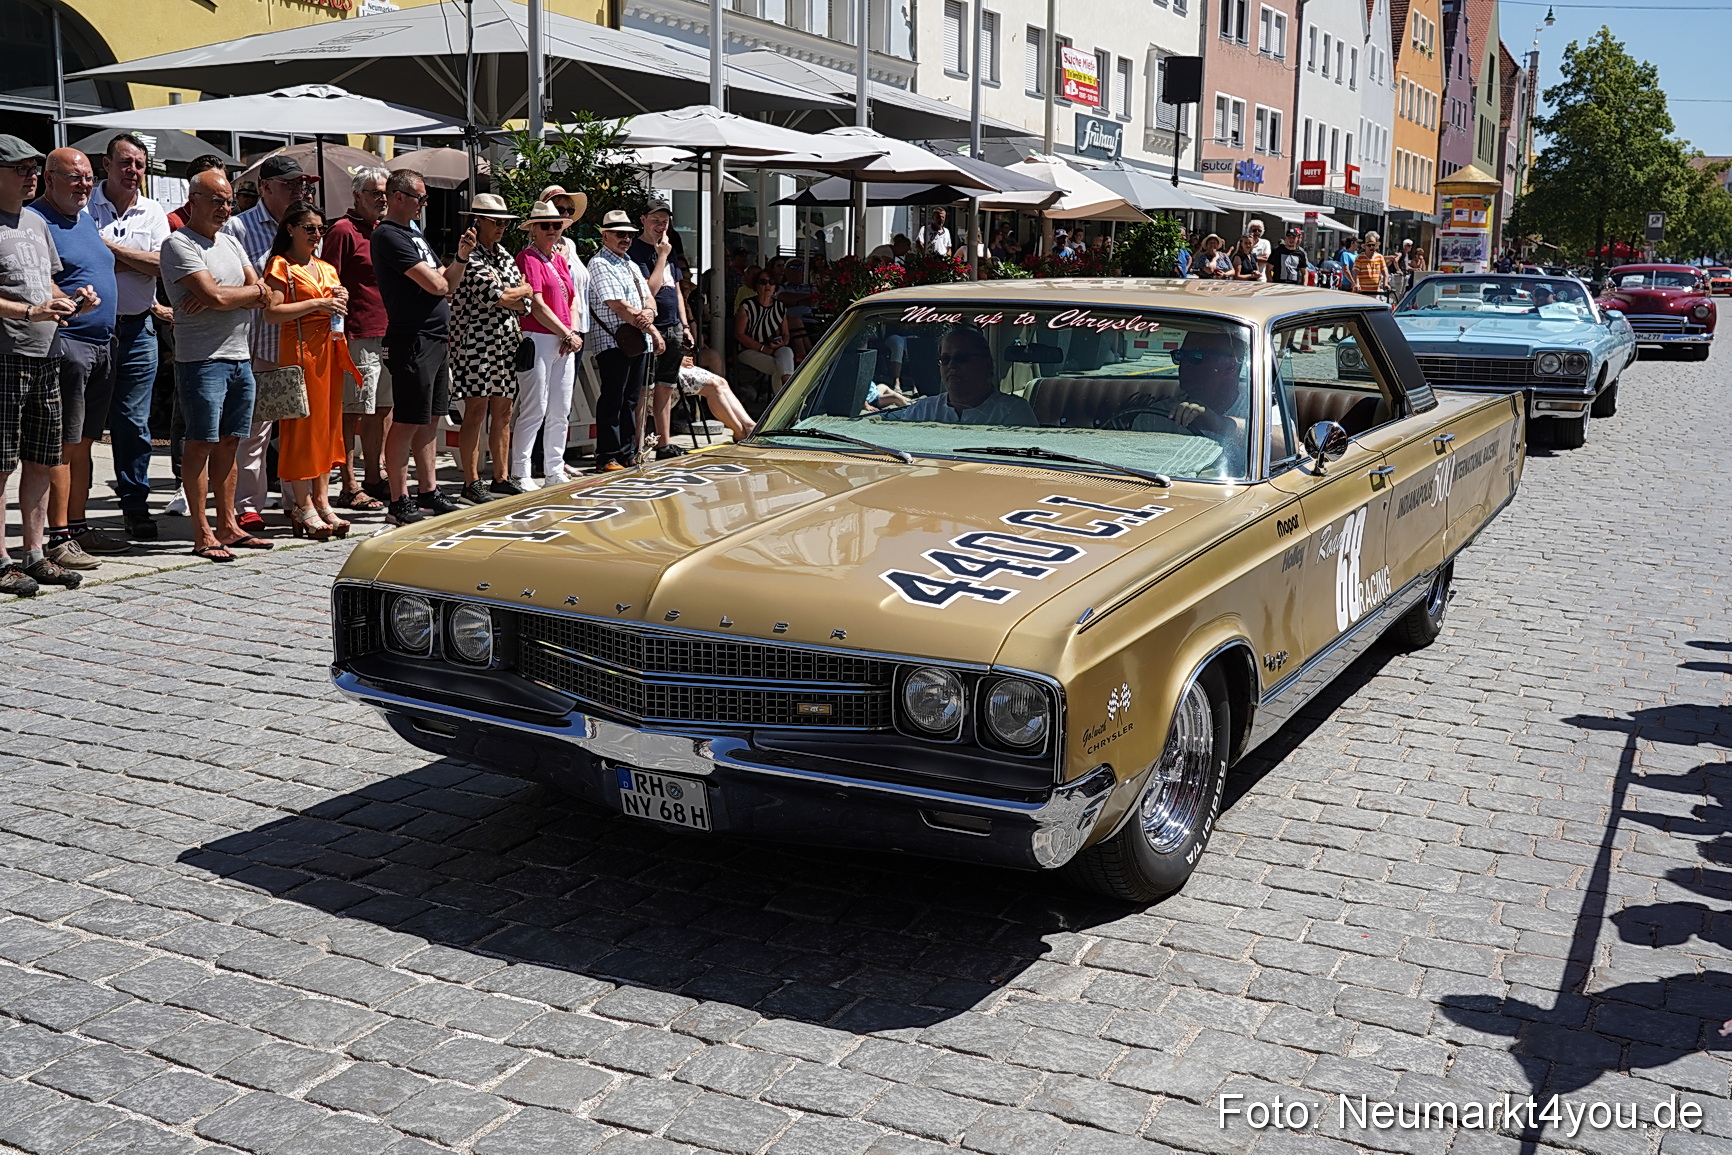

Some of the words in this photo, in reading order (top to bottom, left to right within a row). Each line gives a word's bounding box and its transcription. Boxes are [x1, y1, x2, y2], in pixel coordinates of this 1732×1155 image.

[1303, 168, 1322, 176] WITT
[900, 305, 962, 325] Move
[973, 310, 1003, 330] up
[1013, 311, 1037, 326] to
[1047, 309, 1163, 333] Chrysler
[878, 531, 1088, 610] 440
[1335, 503, 1368, 633] 68
[1357, 564, 1393, 615] RACING
[476, 581, 848, 640] CHRYSLER
[1087, 722, 1134, 755] CHRYSLER
[623, 780, 629, 788] D
[634, 773, 665, 798] RH
[624, 793, 651, 817] NY
[1201, 760, 1227, 840] Radial
[1185, 842, 1203, 865] T/A
